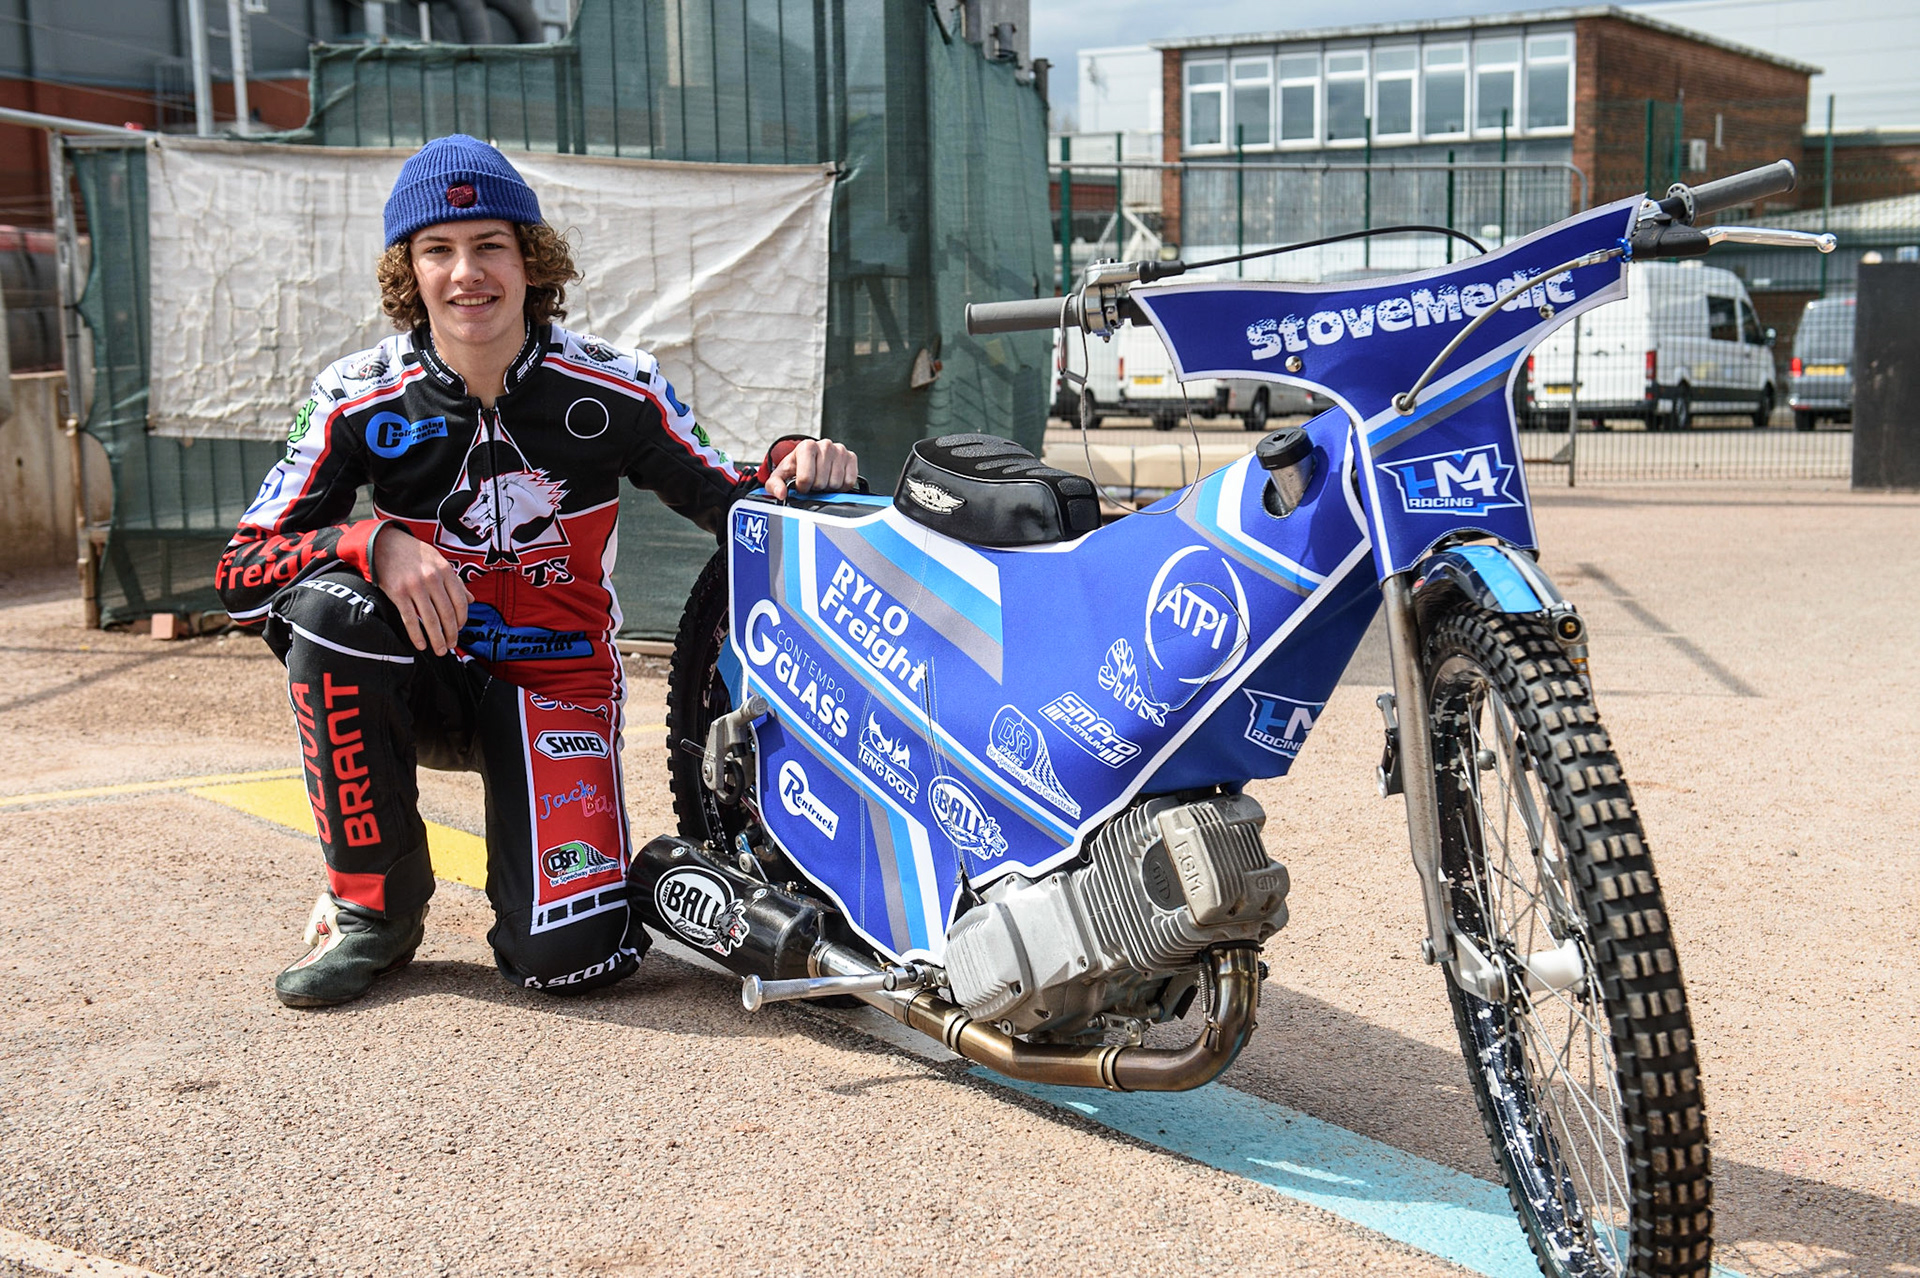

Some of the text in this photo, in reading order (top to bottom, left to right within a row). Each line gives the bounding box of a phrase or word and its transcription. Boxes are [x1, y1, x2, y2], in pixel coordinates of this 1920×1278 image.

[1408, 495, 1475, 509] RACING
[214, 543, 328, 591] Freigh
[831, 559, 910, 637] RYLO
[1156, 582, 1230, 651] ATPI
[819, 584, 927, 693] Freight
[776, 629, 846, 704] CONTEMPO
[774, 652, 850, 739] GLASS
[546, 736, 605, 754] SHOEI
[805, 712, 840, 746] DESIGN
[998, 717, 1032, 761] DSR
[1060, 713, 1106, 751] PLATINUM
[291, 681, 333, 845] OLIVIA
[322, 671, 382, 847] BRANT
[997, 744, 1024, 768] SPARES
[540, 780, 597, 820] Jack
[784, 768, 835, 833] Rentruck
[996, 754, 1028, 784] Speedway
[1028, 780, 1042, 793] and
[1042, 787, 1080, 817] Grasstrack
[550, 849, 579, 872] DSR
[666, 880, 722, 931] BALL
